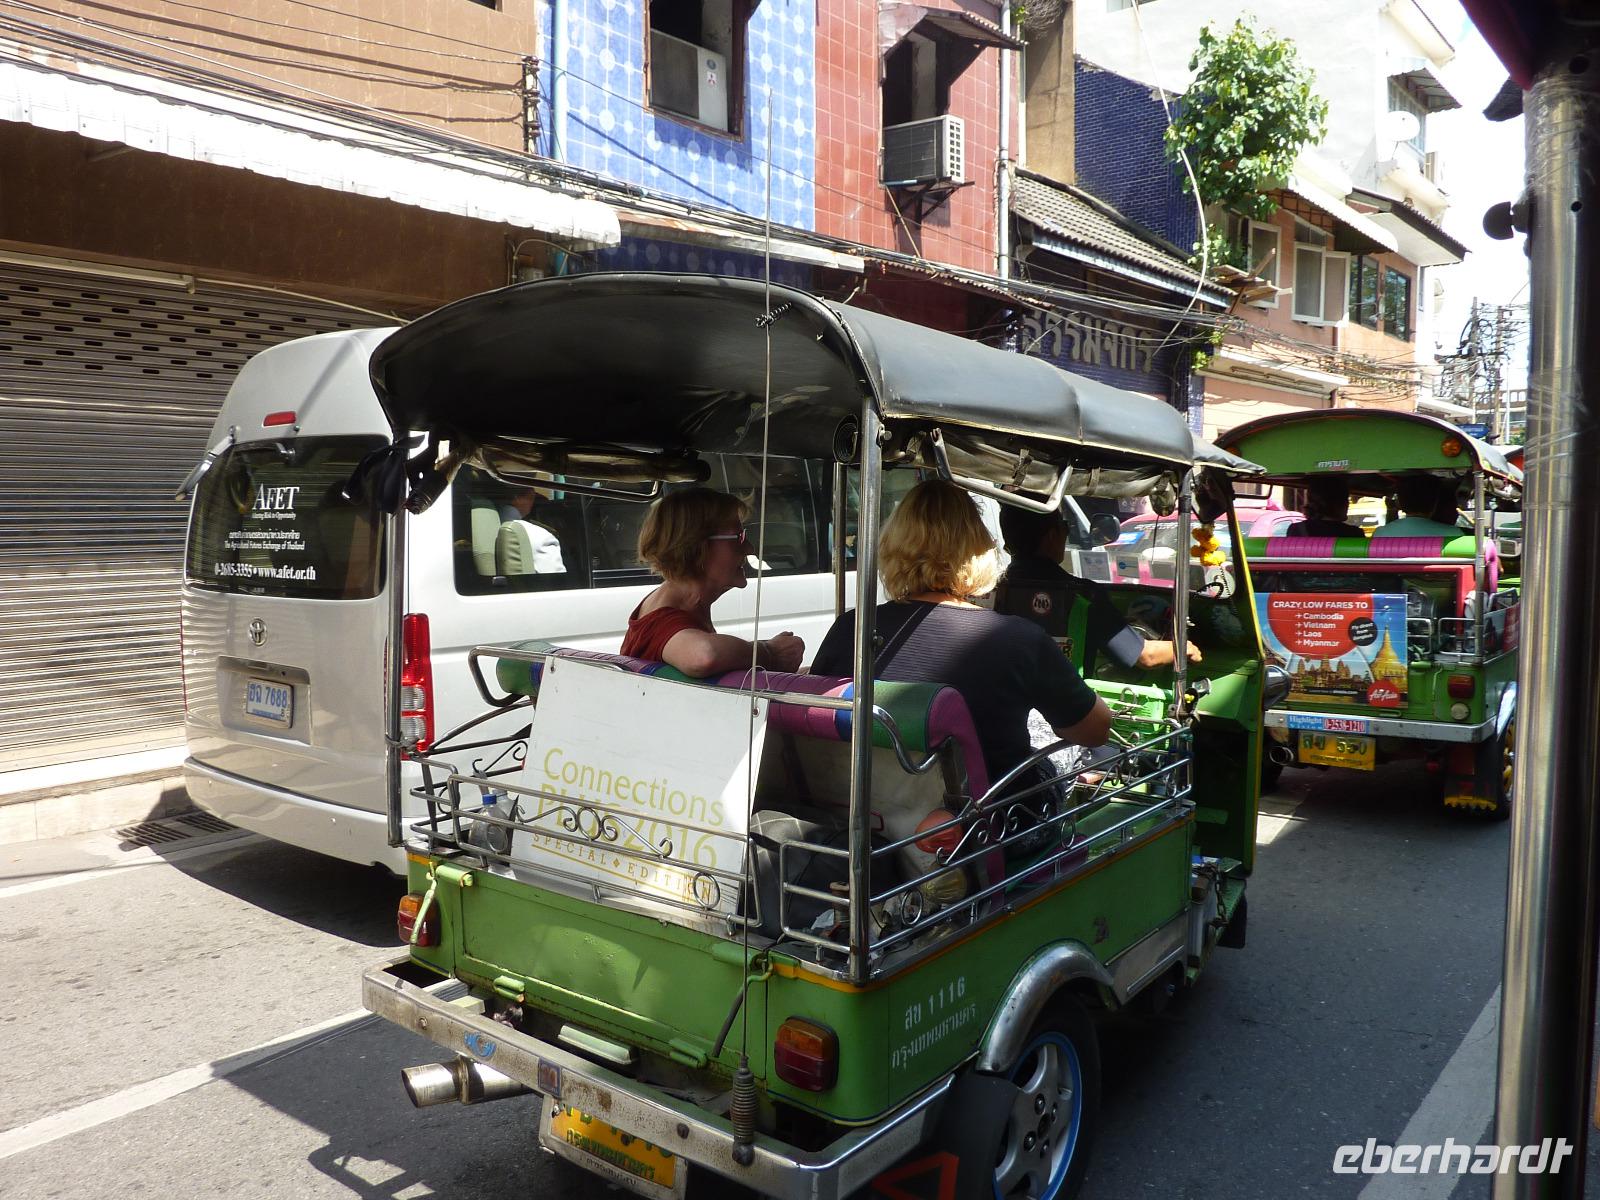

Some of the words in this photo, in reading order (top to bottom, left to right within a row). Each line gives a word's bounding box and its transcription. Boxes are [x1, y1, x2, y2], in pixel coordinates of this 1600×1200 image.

[252, 483, 300, 510] AFET
[1273, 601, 1301, 609] CRAZY
[1303, 601, 1324, 609] LOW
[1303, 612, 1344, 621] Cambodia
[1303, 621, 1336, 629] Vietnam
[1303, 630, 1322, 638] Laos
[1303, 639, 1339, 647] Myanmar
[543, 747, 725, 828] Connections
[928, 976, 966, 1015] 1116
